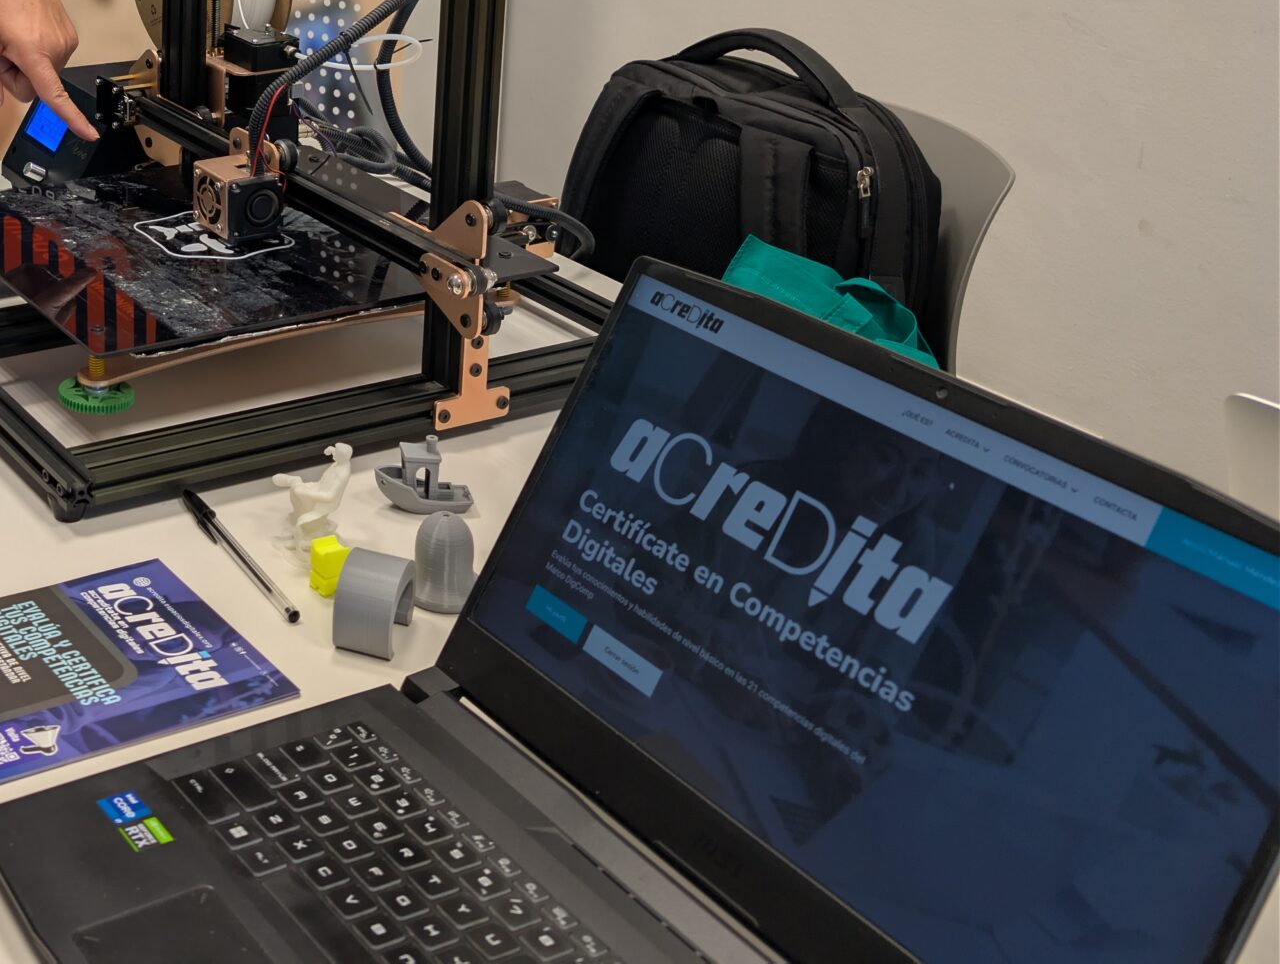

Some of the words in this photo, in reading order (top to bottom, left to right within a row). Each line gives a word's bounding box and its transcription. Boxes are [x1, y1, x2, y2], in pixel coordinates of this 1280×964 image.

[561, 518, 659, 596] Digitales
[18, 600, 62, 640] EVALÚA
[578, 488, 689, 573] Certifícate
[692, 564, 727, 593] en
[727, 581, 916, 714] Competencias
[1, 603, 27, 625] TUS
[19, 627, 99, 706] COMPETENCIAS
[53, 639, 72, 648] Y
[62, 650, 122, 705] CERTIFICA
[125, 825, 151, 848] RTX
